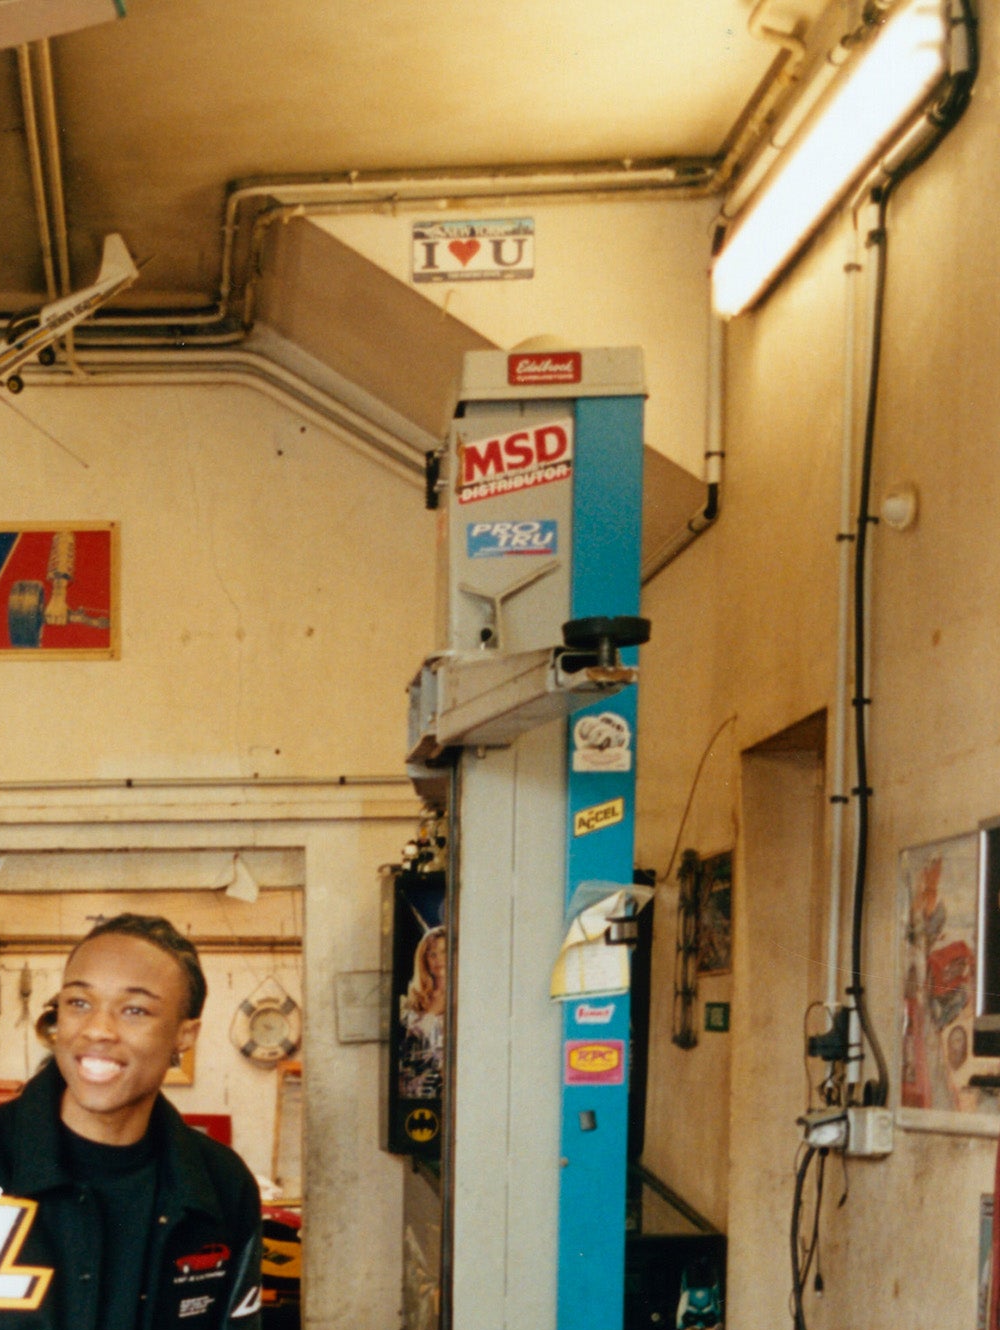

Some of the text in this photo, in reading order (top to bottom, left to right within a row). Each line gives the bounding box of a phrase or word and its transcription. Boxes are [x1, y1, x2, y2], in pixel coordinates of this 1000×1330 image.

[421, 238, 528, 270] I U
[464, 425, 568, 483] MSD
[461, 464, 568, 500] DISTRIBUTOR
[472, 522, 540, 537] PRO
